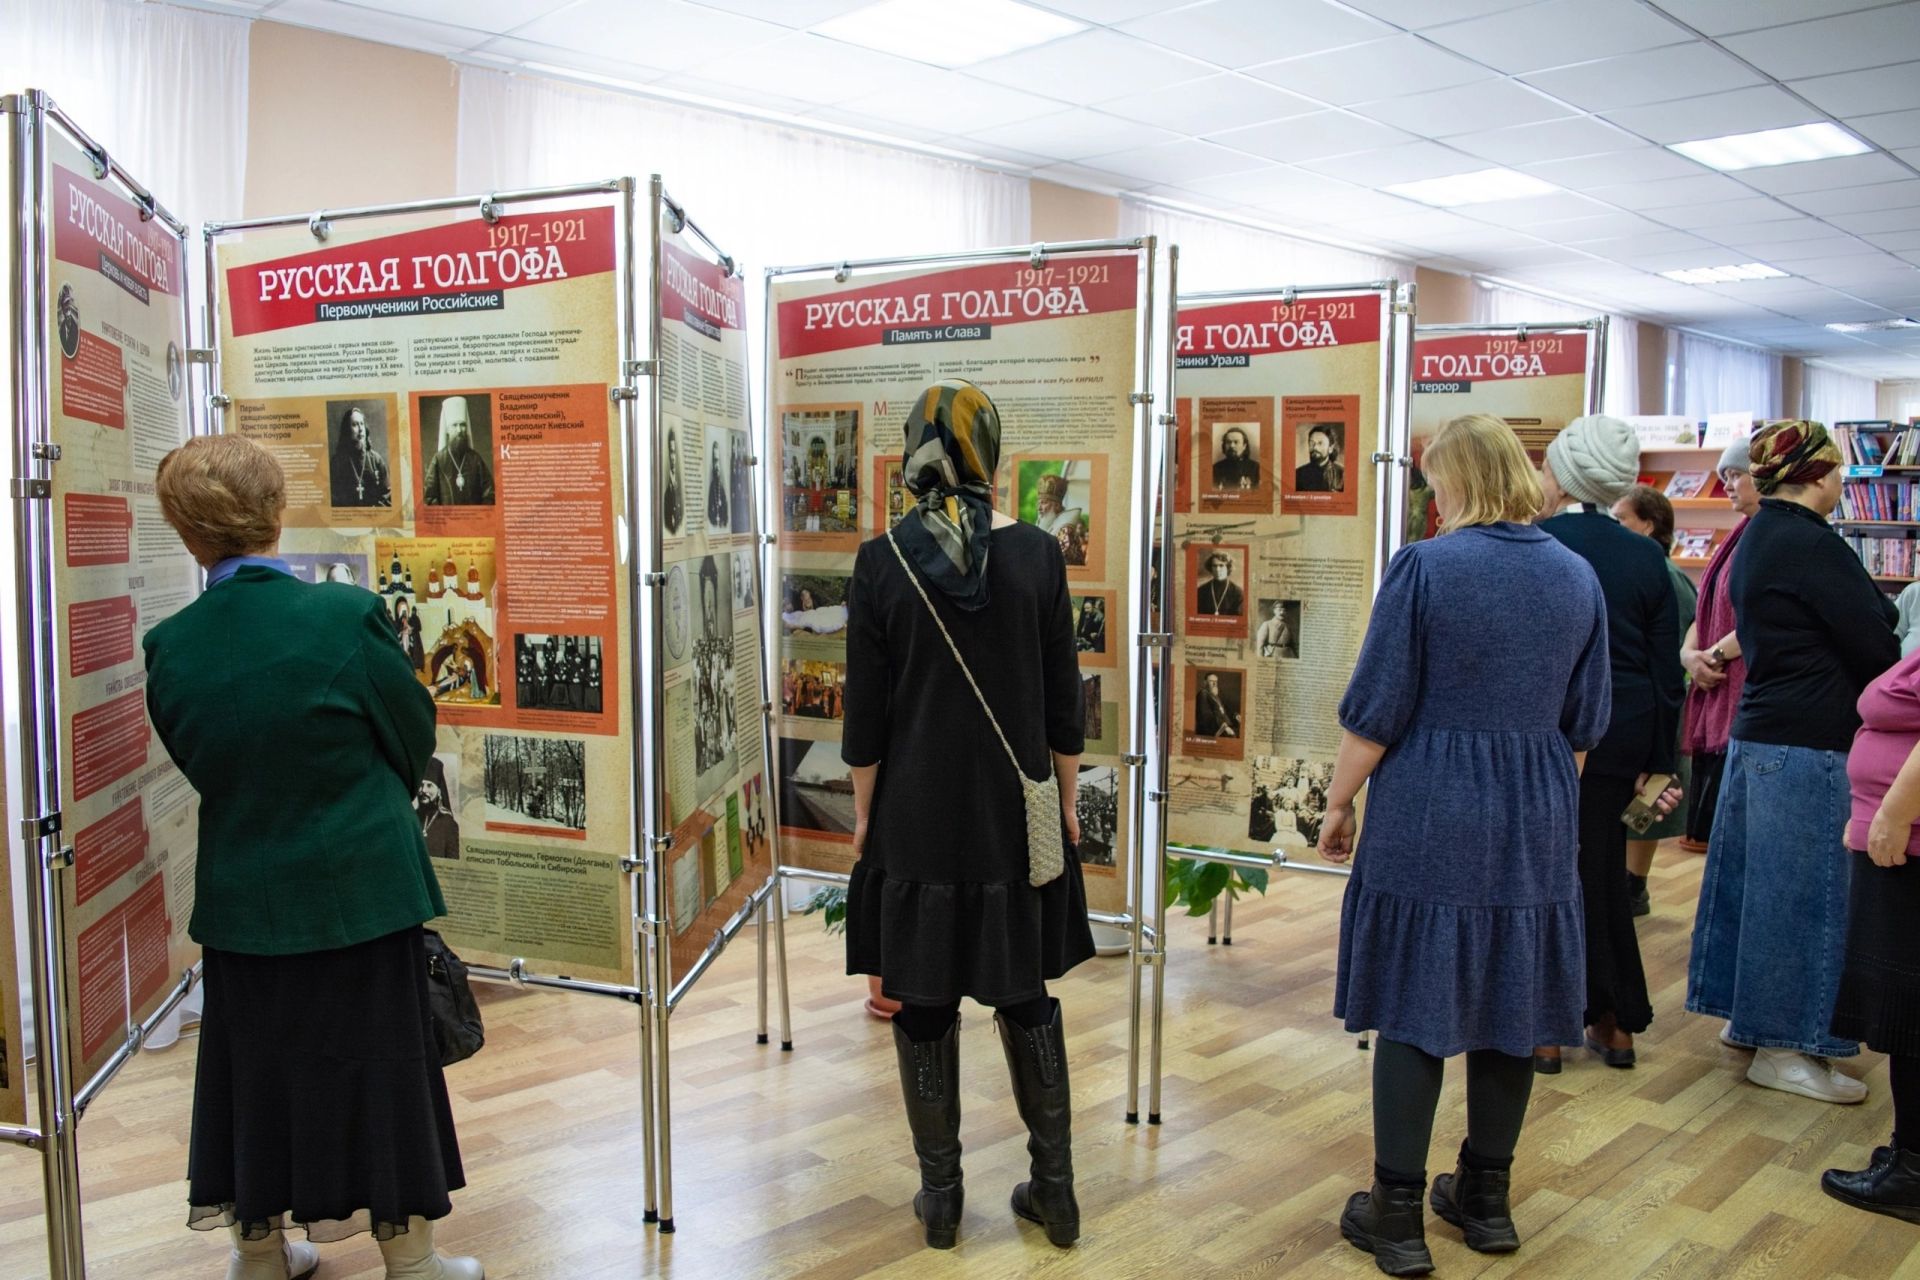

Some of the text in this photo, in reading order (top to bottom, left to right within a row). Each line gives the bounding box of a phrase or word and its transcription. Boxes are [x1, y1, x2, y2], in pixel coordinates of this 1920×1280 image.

[68, 182, 169, 292] РУССКАЯ ГОЛГОФА
[488, 219, 586, 248] 1917-1921
[259, 245, 567, 301] РУССКАЯ ГОЛГОФА
[1015, 265, 1109, 288] 1917-1921
[320, 293, 498, 320] Первомученики Российские
[804, 285, 1089, 330] РУССКАЯ ГОЛГОФА
[1271, 303, 1356, 322] 1917-1921
[891, 324, 981, 344] Память и Слава
[1204, 320, 1338, 350] ГОЛГОФА
[1485, 339, 1564, 354] 1917-1921
[1211, 354, 1246, 368] Урала
[1422, 354, 1546, 377] ГОЛГОФА
[1420, 382, 1460, 394] террор
[499, 391, 571, 402] Священномученик
[500, 402, 538, 412] Владимир
[500, 410, 567, 422] (Богоявленский),
[269, 420, 309, 432] протоиерей
[500, 420, 585, 432] митрополит Киевский
[263, 431, 292, 441] Кочуров
[507, 431, 543, 441] Галицкий
[496, 858, 539, 869] Тобольский
[547, 862, 587, 875] Сибирский
[537, 852, 572, 865] Гермоген
